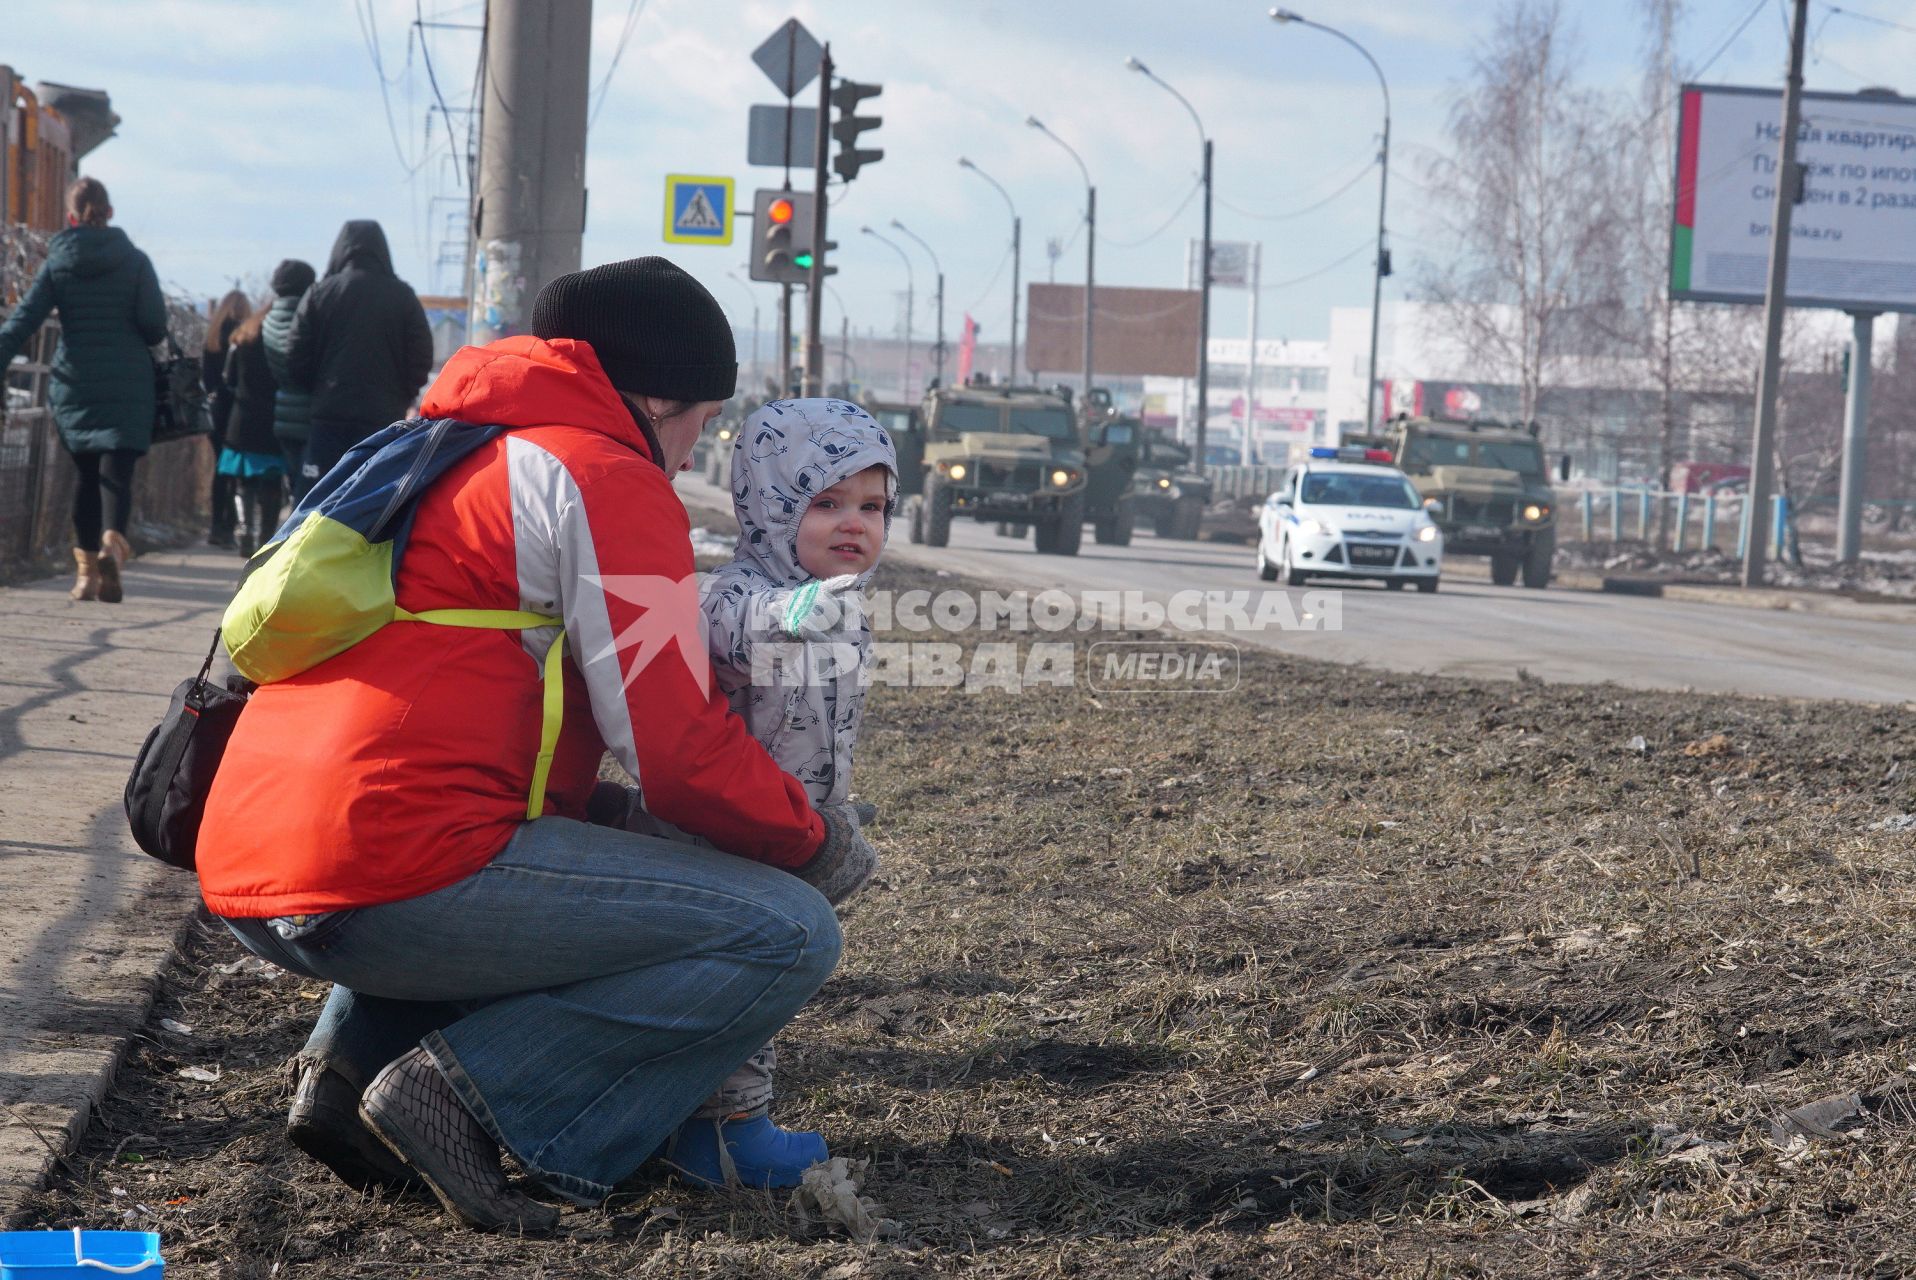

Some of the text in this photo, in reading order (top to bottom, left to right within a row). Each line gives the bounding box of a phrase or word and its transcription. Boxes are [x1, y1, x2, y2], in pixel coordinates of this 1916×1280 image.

[1755, 121, 1916, 151] Ноая квартир
[1841, 163, 1867, 179] по
[1838, 190, 1850, 205] в
[1855, 186, 1868, 206] 2
